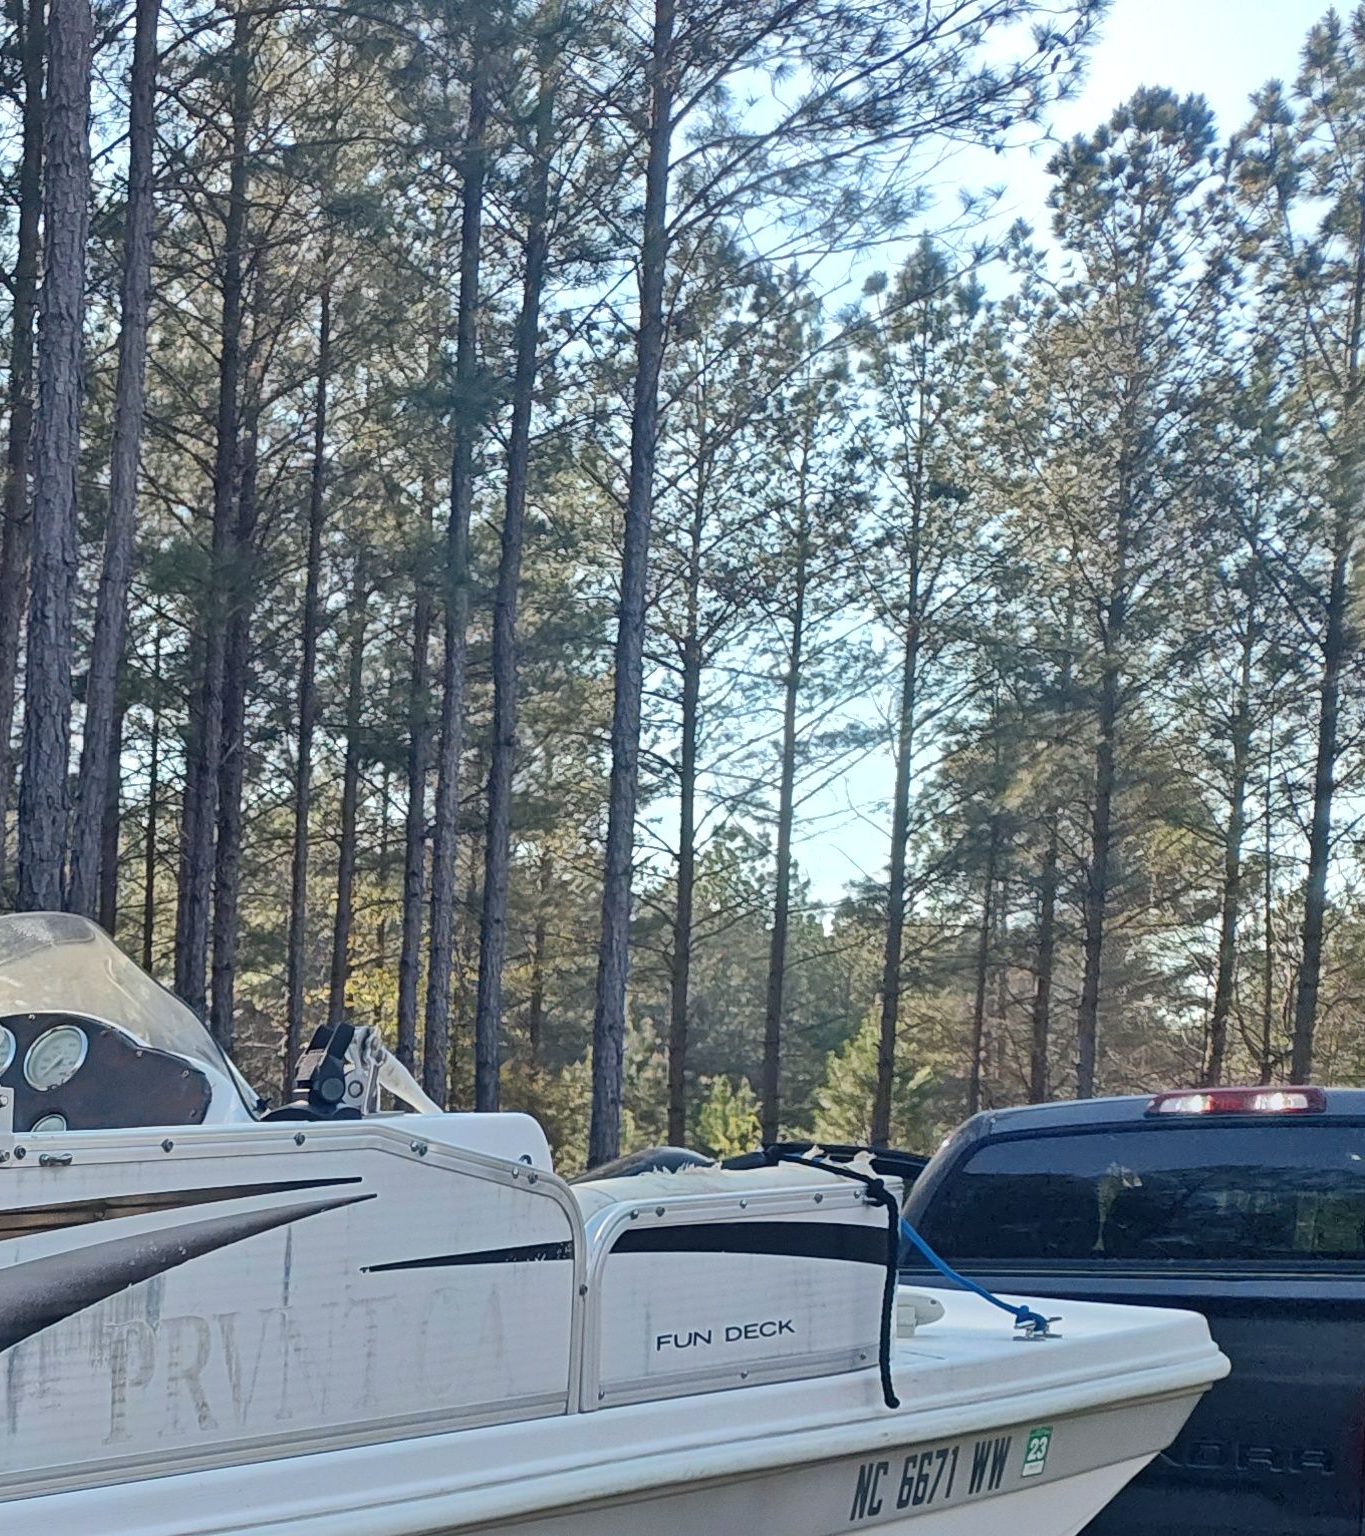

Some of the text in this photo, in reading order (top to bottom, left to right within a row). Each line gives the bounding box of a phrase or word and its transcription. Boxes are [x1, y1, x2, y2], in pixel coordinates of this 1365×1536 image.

[656, 1319, 795, 1351] FUN DECK
[1026, 1436, 1049, 1461] 23
[849, 1436, 1012, 1521] NC 6671 WW
